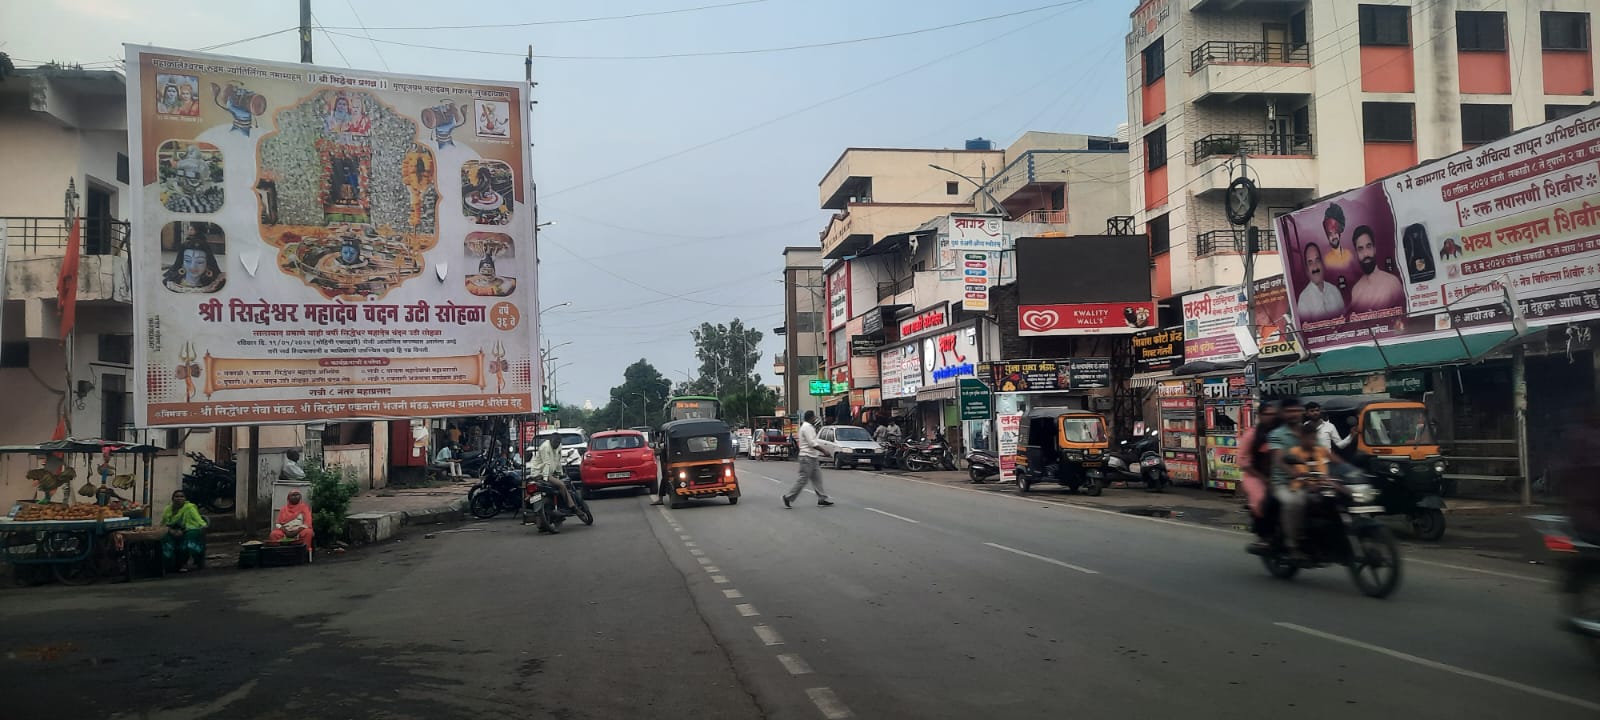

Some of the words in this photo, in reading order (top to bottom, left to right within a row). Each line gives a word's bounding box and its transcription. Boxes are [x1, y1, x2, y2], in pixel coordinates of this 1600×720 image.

[318, 75, 328, 84] श्री
[1405, 173, 1413, 190] मे
[1415, 170, 1446, 187] कामगार
[1448, 156, 1473, 179] दिनाचे
[1476, 147, 1511, 169] औचित्य
[1513, 139, 1542, 157] साधून
[1470, 178, 1489, 191] २०२४
[1508, 164, 1531, 179] सकाळी
[1472, 200, 1493, 218] रक्त
[1494, 184, 1541, 211] तपासणी
[1543, 173, 1584, 199] शिबीर
[954, 218, 1000, 238] सागर
[1461, 231, 1493, 253] भव्य
[1495, 217, 1551, 246] रक्तदान
[1523, 248, 1546, 264] सकाळी
[1519, 273, 1531, 289] नेत्र
[1532, 270, 1562, 287] चिकित्सा
[1562, 267, 1585, 282] शिबीर
[198, 298, 223, 323] श्री
[229, 298, 298, 325] सिद्धेश्वर
[303, 299, 357, 325] महादेव
[362, 297, 399, 325] चंदन
[404, 299, 430, 323] उटी
[434, 299, 486, 325] सोहळा
[1074, 309, 1109, 317] KWALITY
[1184, 293, 1212, 320] लक्ष्मी
[1463, 307, 1496, 323] आयोजक
[1558, 293, 1582, 310] आणि
[1077, 317, 1103, 325] WALL'S
[367, 328, 389, 338] महादेव
[391, 328, 407, 338] चंदन
[1258, 342, 1296, 356] XEROX
[356, 386, 391, 396] महाप्रसाद
[1203, 377, 1229, 399] वर्मा
[200, 404, 212, 416] श्री
[214, 404, 250, 418] सिद्धेश्वर
[252, 403, 270, 415] सेवा
[300, 401, 311, 412] श्री
[313, 400, 346, 414] सिद्धेश्वर
[348, 399, 380, 410] एकतारी
[383, 399, 407, 409] भजनी
